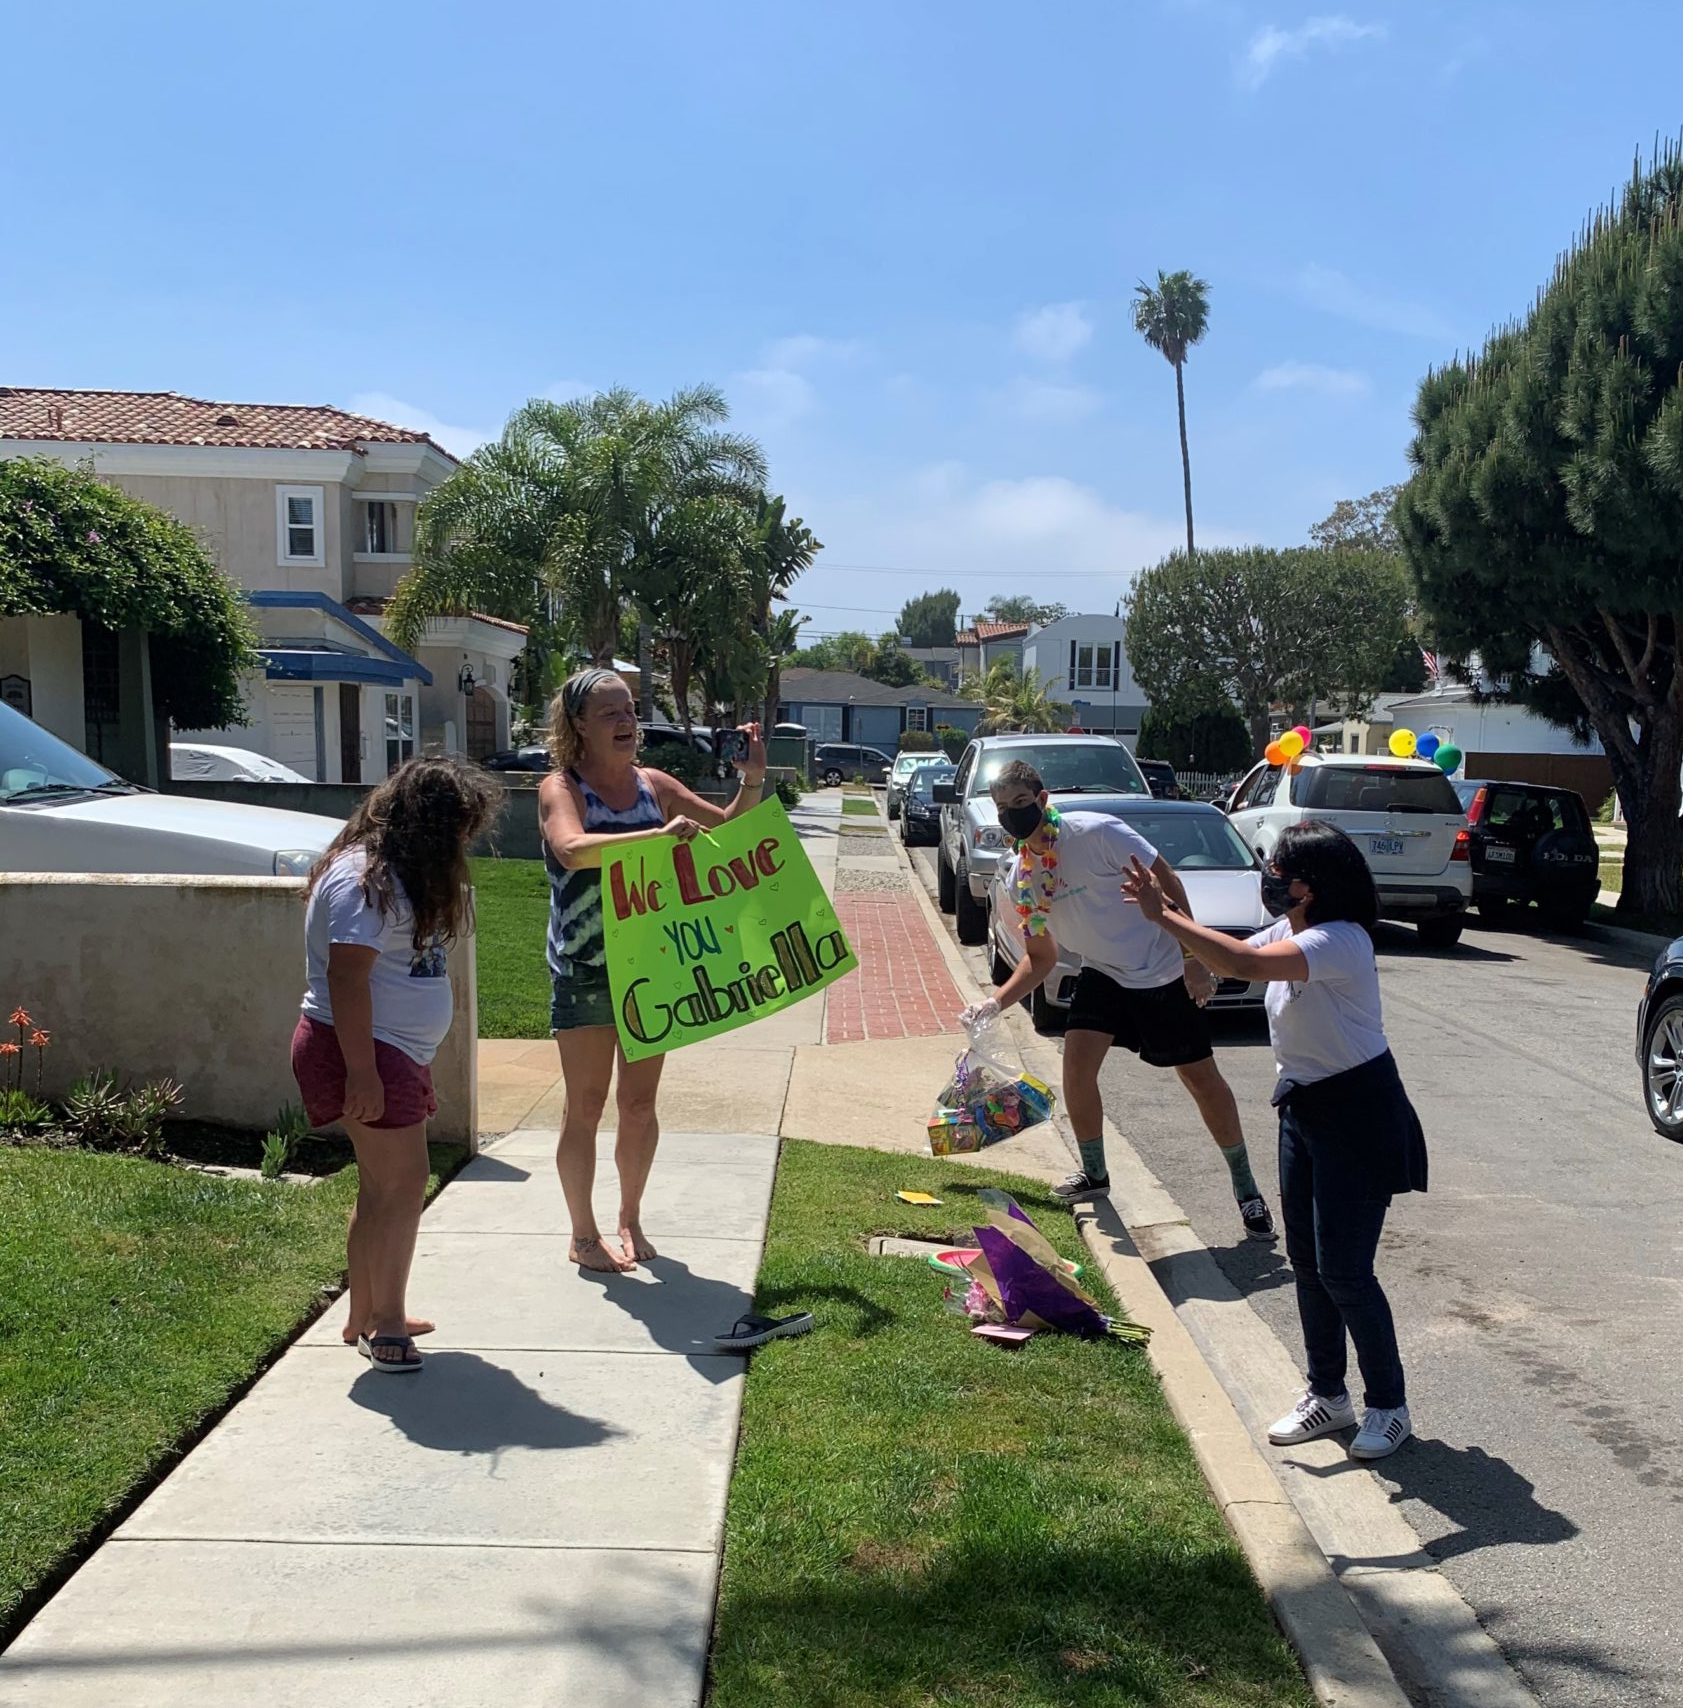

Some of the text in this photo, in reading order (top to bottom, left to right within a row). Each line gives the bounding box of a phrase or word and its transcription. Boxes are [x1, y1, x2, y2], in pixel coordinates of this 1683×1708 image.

[609, 837, 786, 921] We Love
[622, 920, 849, 1044] Gabriella
